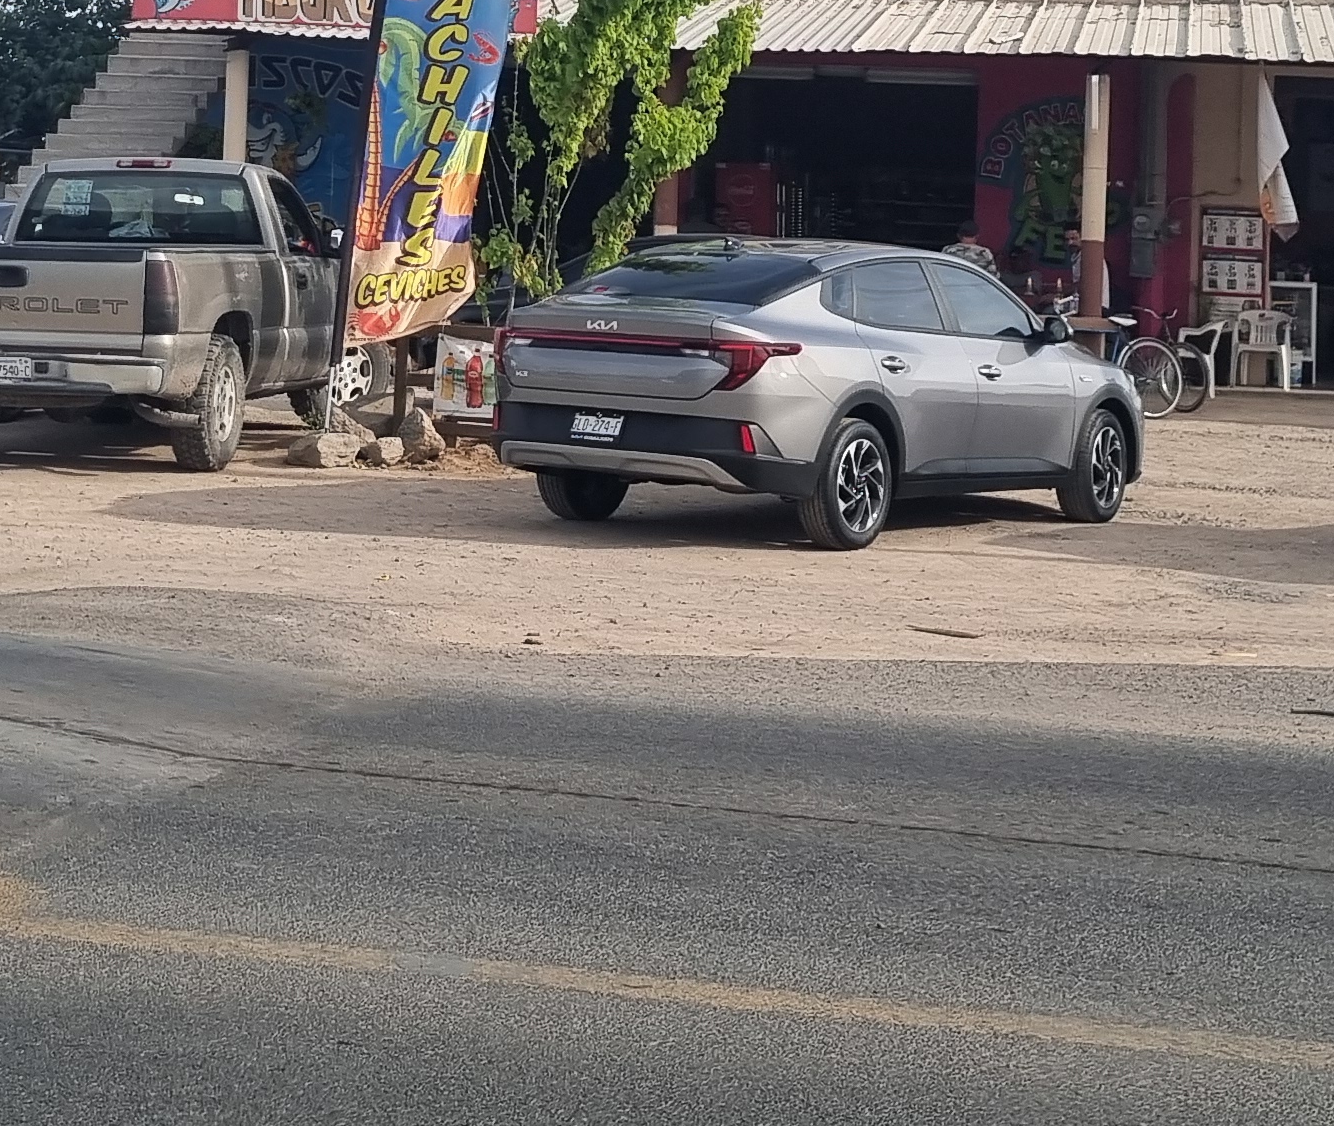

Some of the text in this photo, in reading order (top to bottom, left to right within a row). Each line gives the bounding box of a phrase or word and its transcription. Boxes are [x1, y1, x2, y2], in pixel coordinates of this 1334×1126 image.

[249, 54, 365, 110] ISCOS
[980, 103, 1085, 178] BOTANA
[355, 265, 466, 309] CEVICHES
[587, 319, 618, 331] KIA
